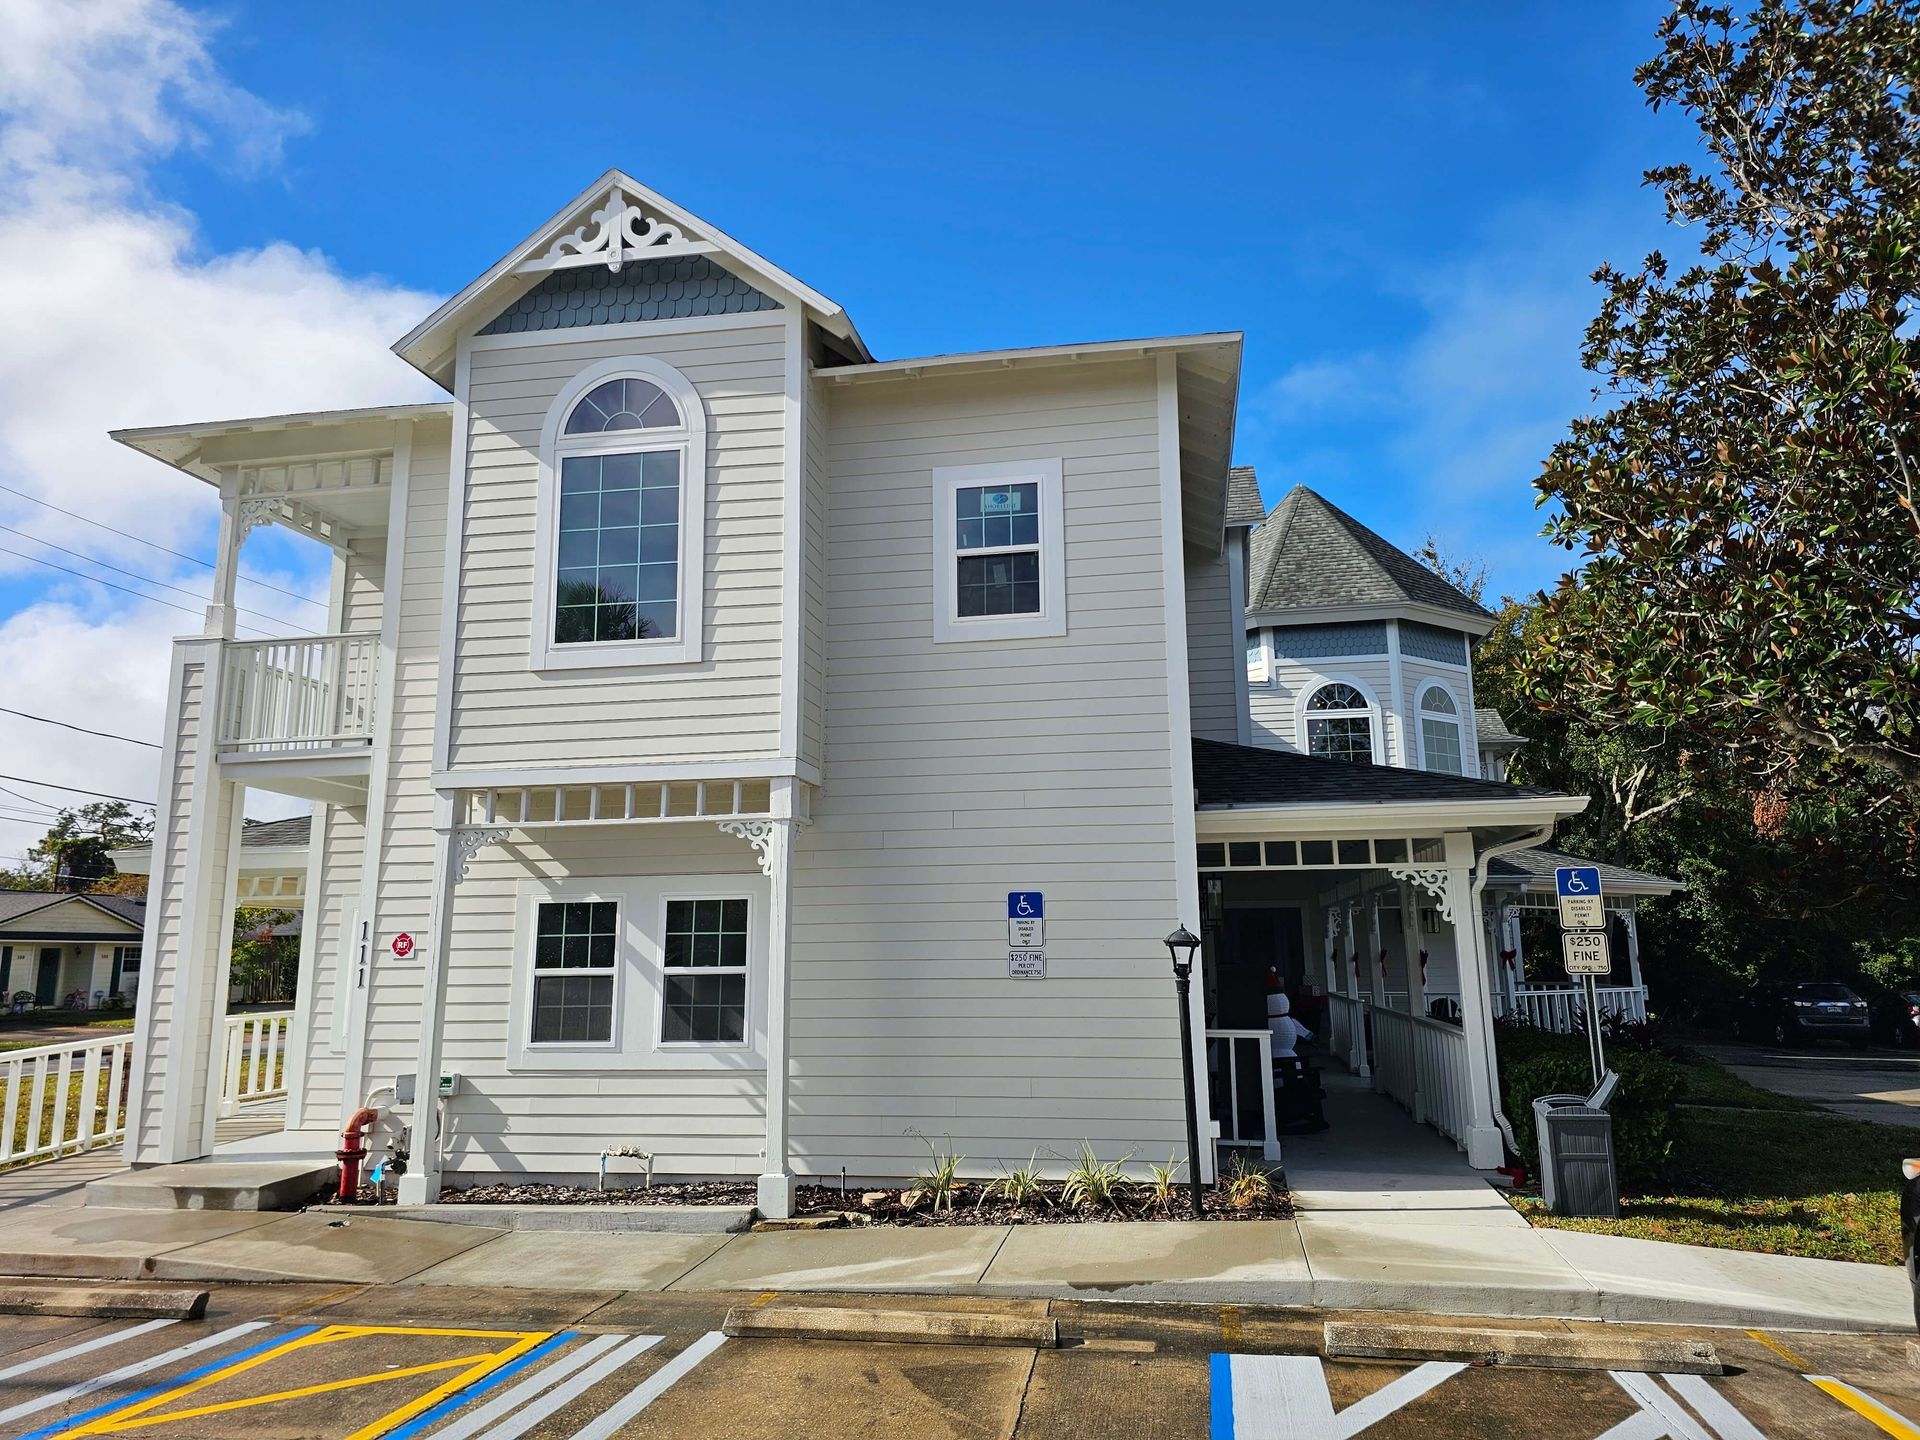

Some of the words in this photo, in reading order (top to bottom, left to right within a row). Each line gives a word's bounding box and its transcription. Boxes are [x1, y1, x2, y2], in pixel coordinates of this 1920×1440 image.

[398, 941, 408, 949] RF
[1569, 936, 1601, 947] $250
[1010, 953, 1027, 961] $250
[1029, 953, 1042, 961] FINE
[1573, 951, 1600, 961] FINE
